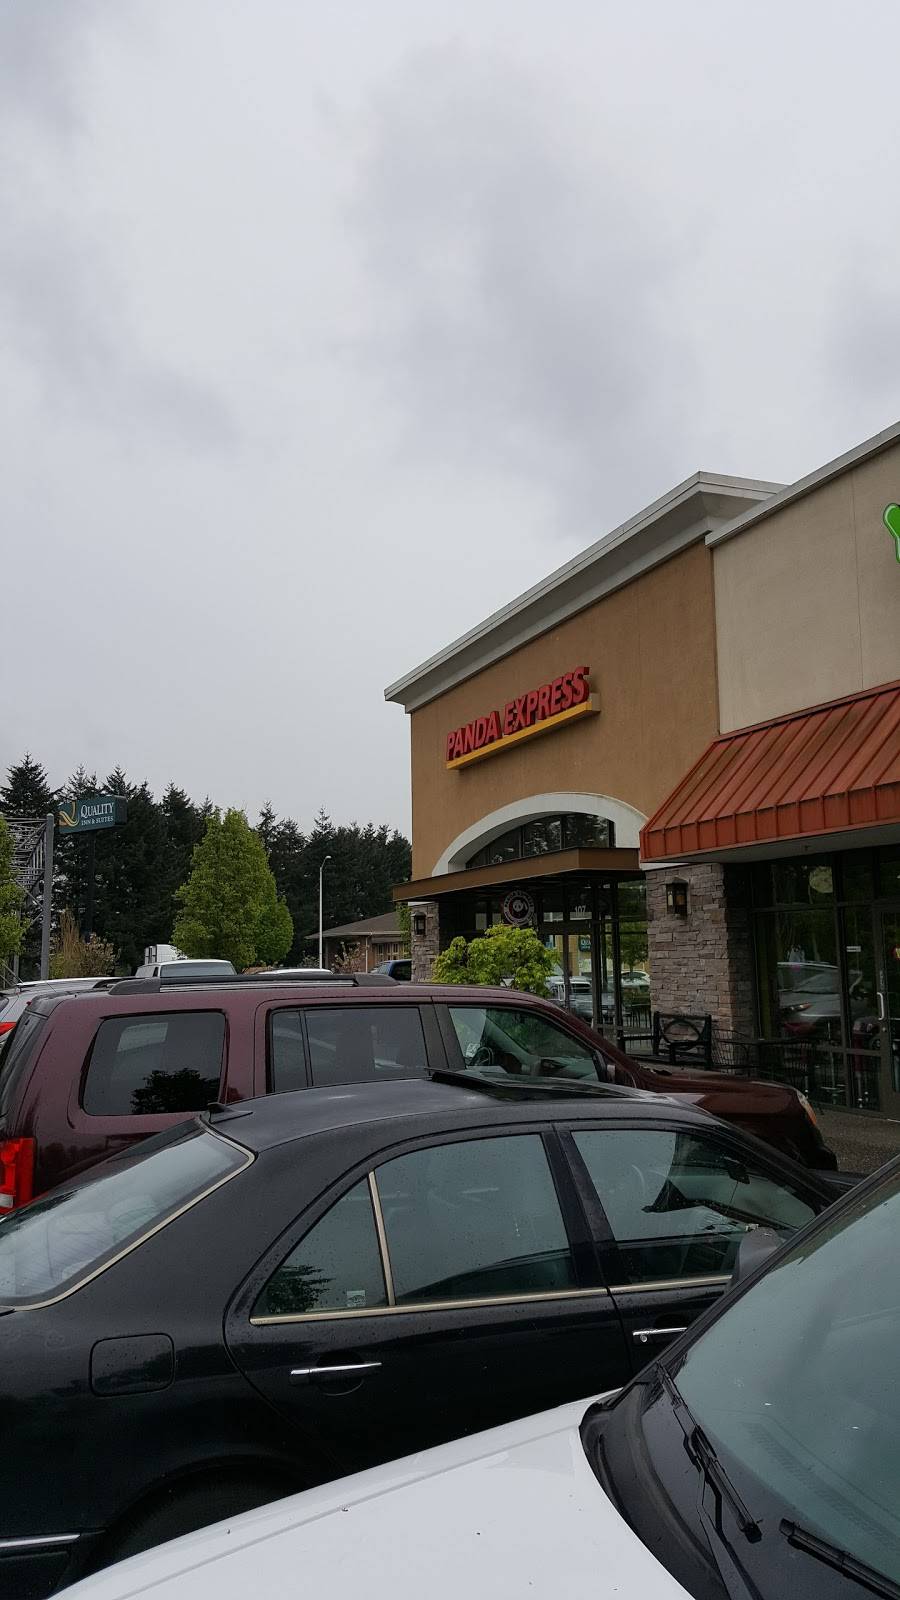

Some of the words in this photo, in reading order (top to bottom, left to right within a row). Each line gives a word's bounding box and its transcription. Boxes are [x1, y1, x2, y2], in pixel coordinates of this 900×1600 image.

[447, 711, 501, 761] PANDA
[503, 666, 590, 735] EXPRESS
[81, 803, 114, 818] QUALITY
[96, 816, 114, 825] SUITES
[574, 905, 586, 917] 107
